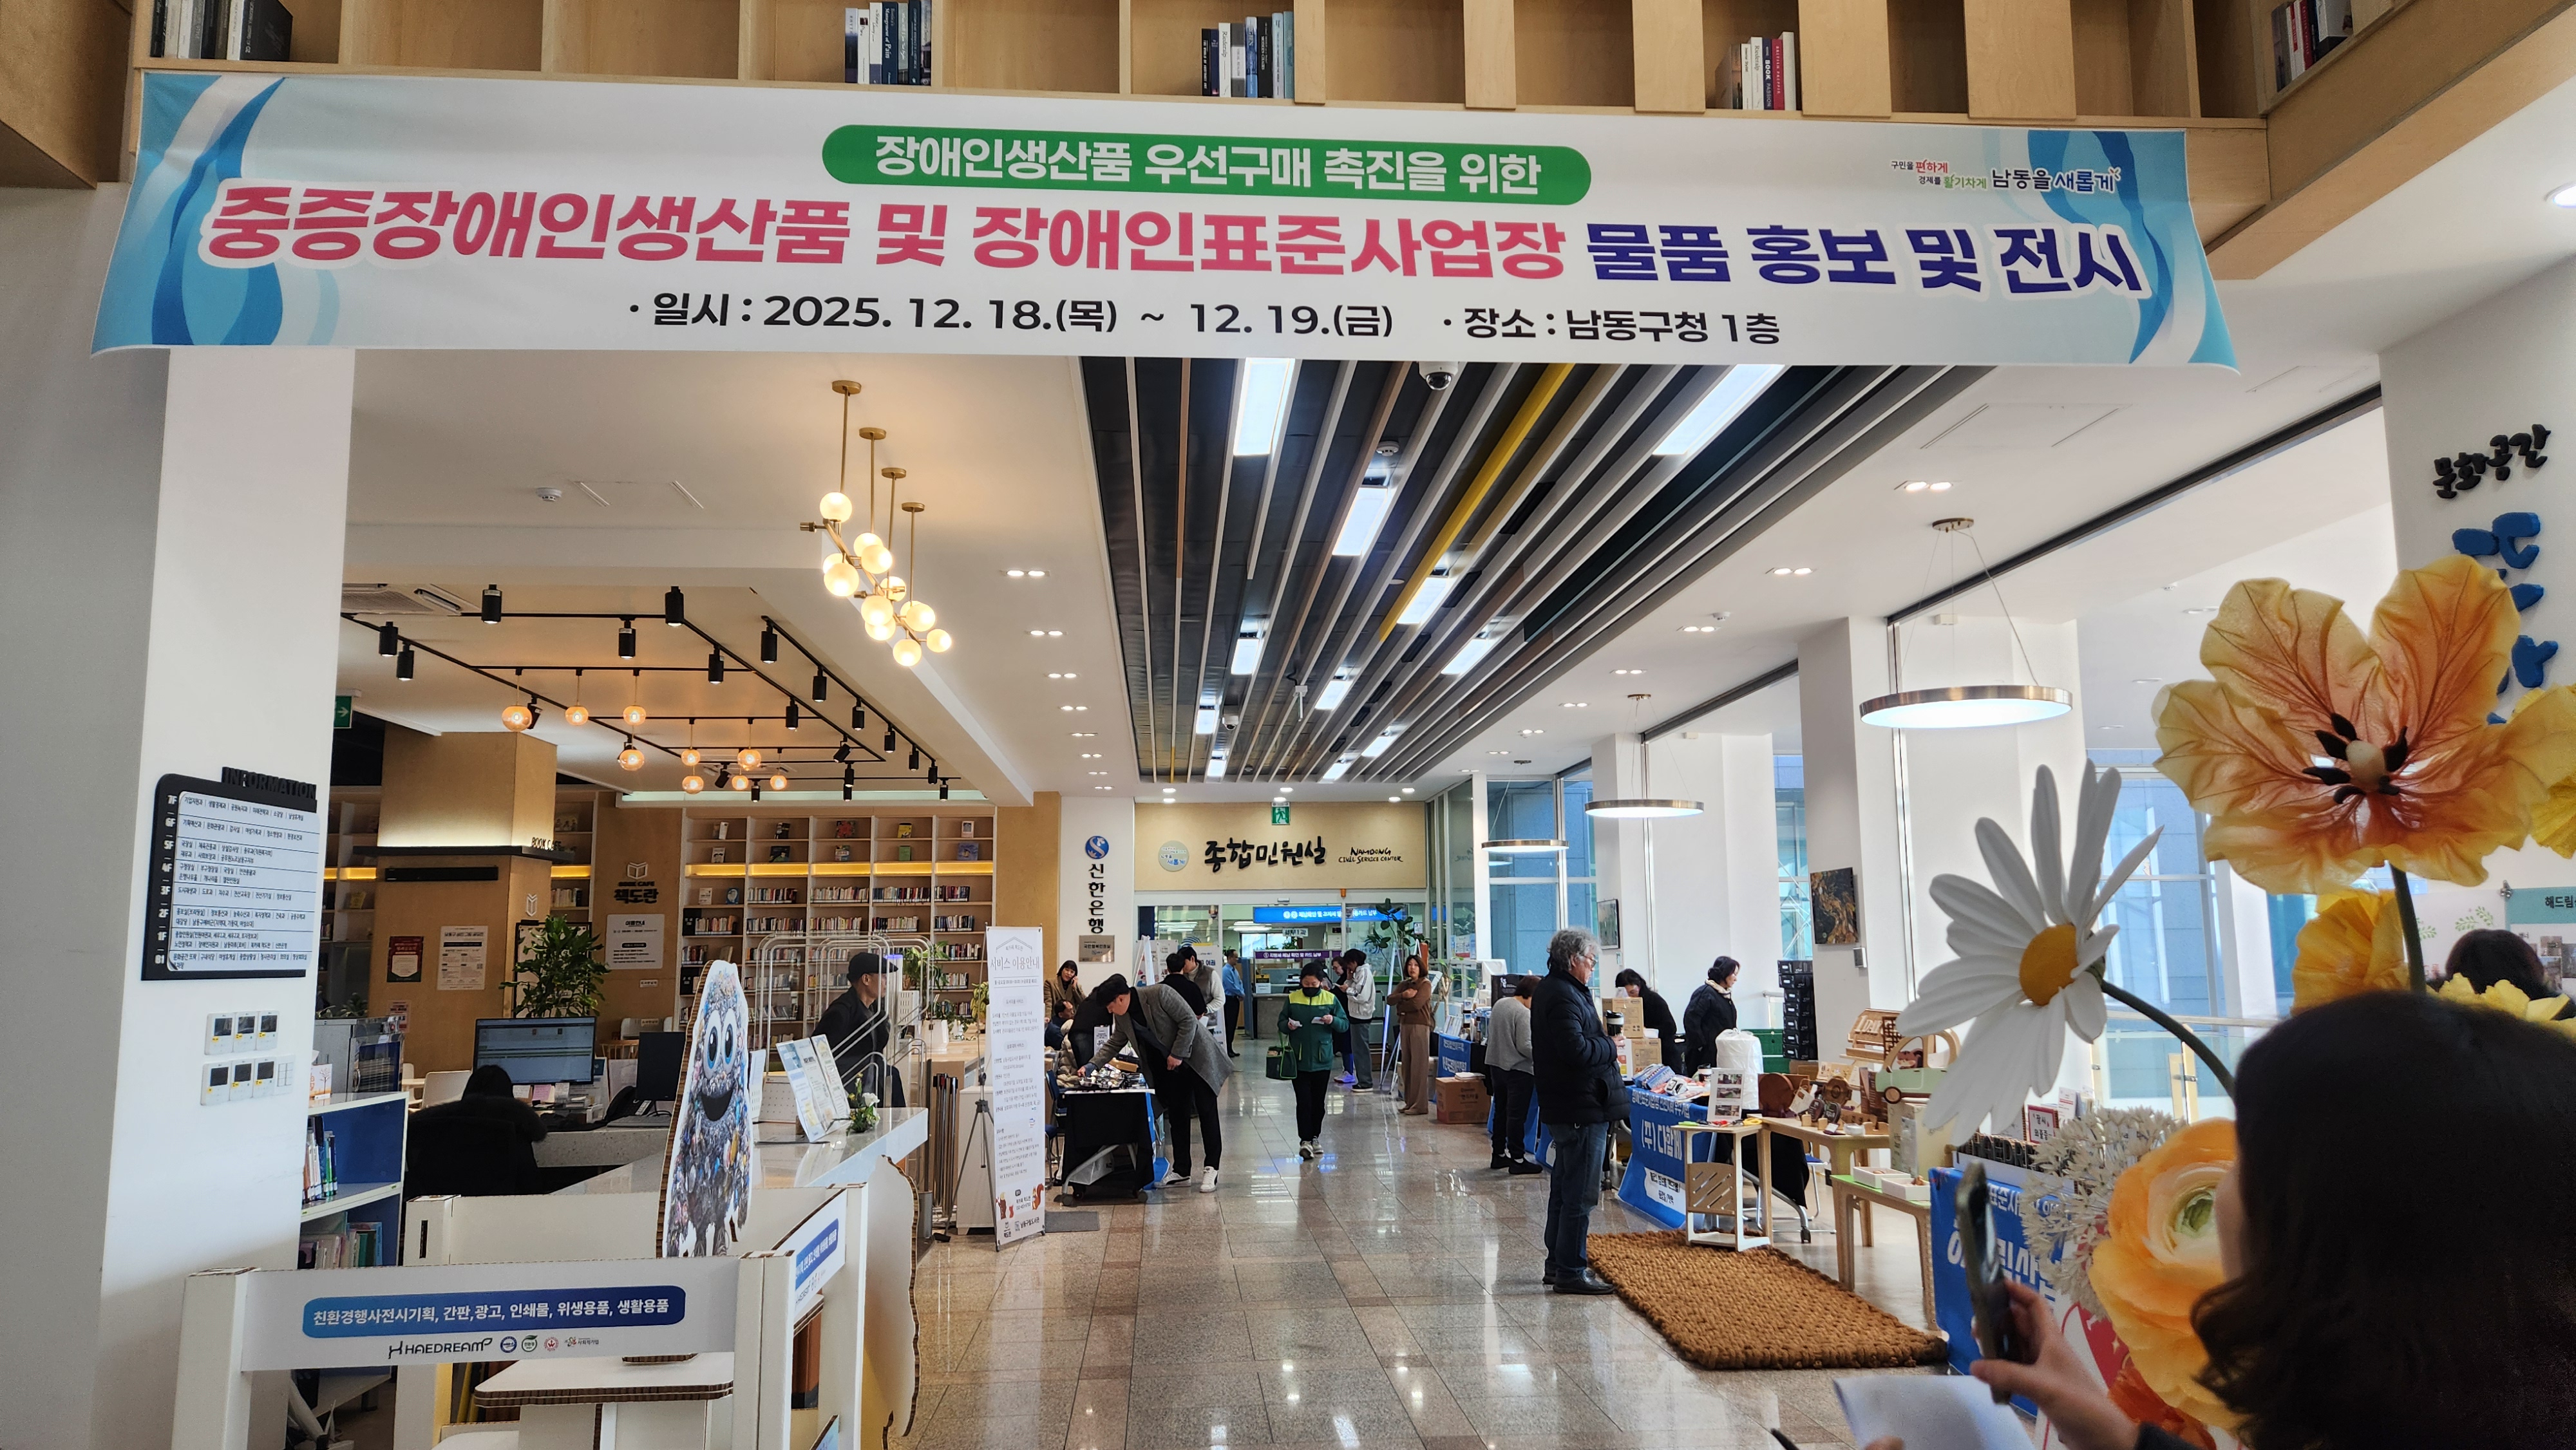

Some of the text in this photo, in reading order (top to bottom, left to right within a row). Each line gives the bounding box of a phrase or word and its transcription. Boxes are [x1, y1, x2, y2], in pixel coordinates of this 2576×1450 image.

[875, 135, 1541, 195] 장애인생산품 우선구매 촉진을 위한
[1891, 159, 1949, 174] 구민을 편하게
[1918, 169, 2115, 193] 경제를 활기차게 남동을 새롭게
[209, 186, 2144, 294] 중증장애인생산품 및 장애인표준사업장 물품 홍보 및 전시
[762, 296, 893, 328] 2025.
[909, 298, 972, 330] 12.
[989, 297, 1118, 335] 18.(목)
[1191, 303, 1253, 335] 12.
[1267, 304, 1394, 339] 19.(금)
[1566, 309, 1707, 344] 남동구청
[2433, 423, 2552, 499] 문화공간
[223, 767, 316, 800] INFORMATION
[531, 836, 562, 851] BOOK CAFE
[1204, 836, 1326, 873] 종합민원실
[1350, 847, 1392, 856] NAMDONG
[1338, 855, 1354, 863] CIVIL
[1356, 855, 1379, 865] SERVICE
[614, 888, 659, 904] 책도란
[1088, 863, 1106, 934] 신한은행
[2544, 895, 2576, 909] 헤드림
[990, 956, 1039, 971] 서비스 이용안내
[313, 1304, 439, 1326] 친환경행사전시기획,
[509, 1300, 553, 1321] 인쇄물,
[557, 1298, 614, 1319] 위생용품,
[617, 1297, 670, 1316] 생활용품
[405, 1337, 493, 1355] HAEDREAM
